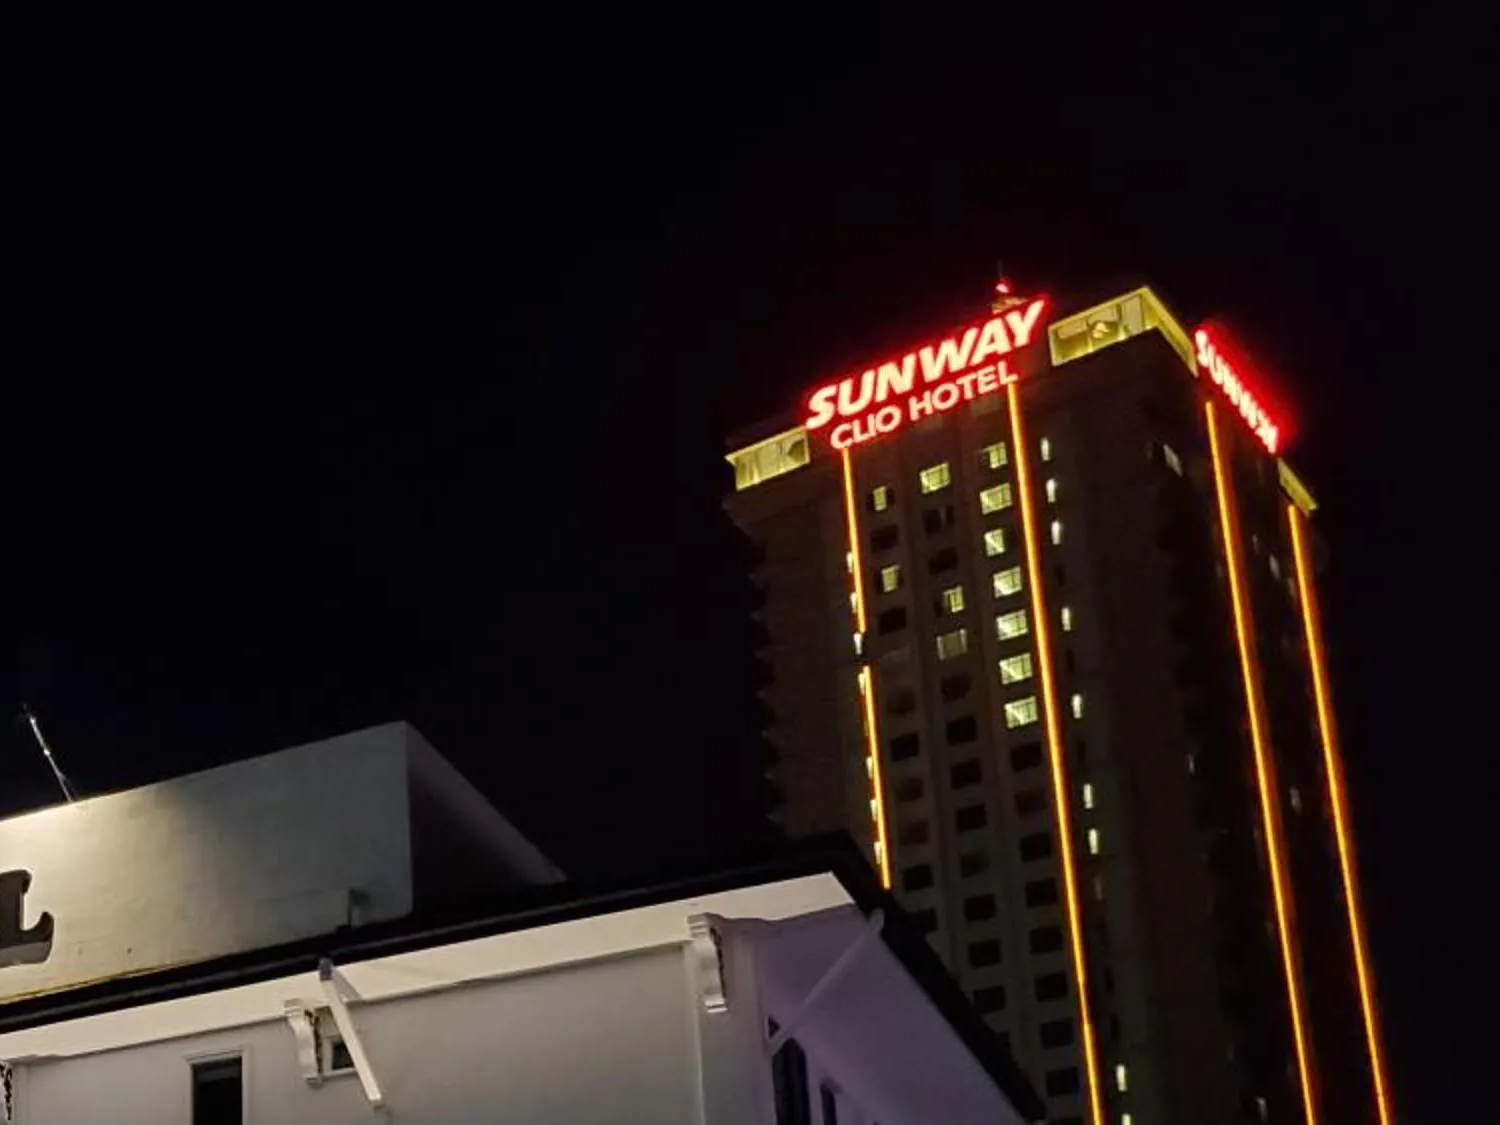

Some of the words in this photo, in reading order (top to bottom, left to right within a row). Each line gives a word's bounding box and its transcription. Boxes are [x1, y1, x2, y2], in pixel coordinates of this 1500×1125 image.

[804, 300, 1047, 429] SUNWAY
[829, 404, 903, 450] CLIO
[909, 361, 1019, 422] HOTEL
